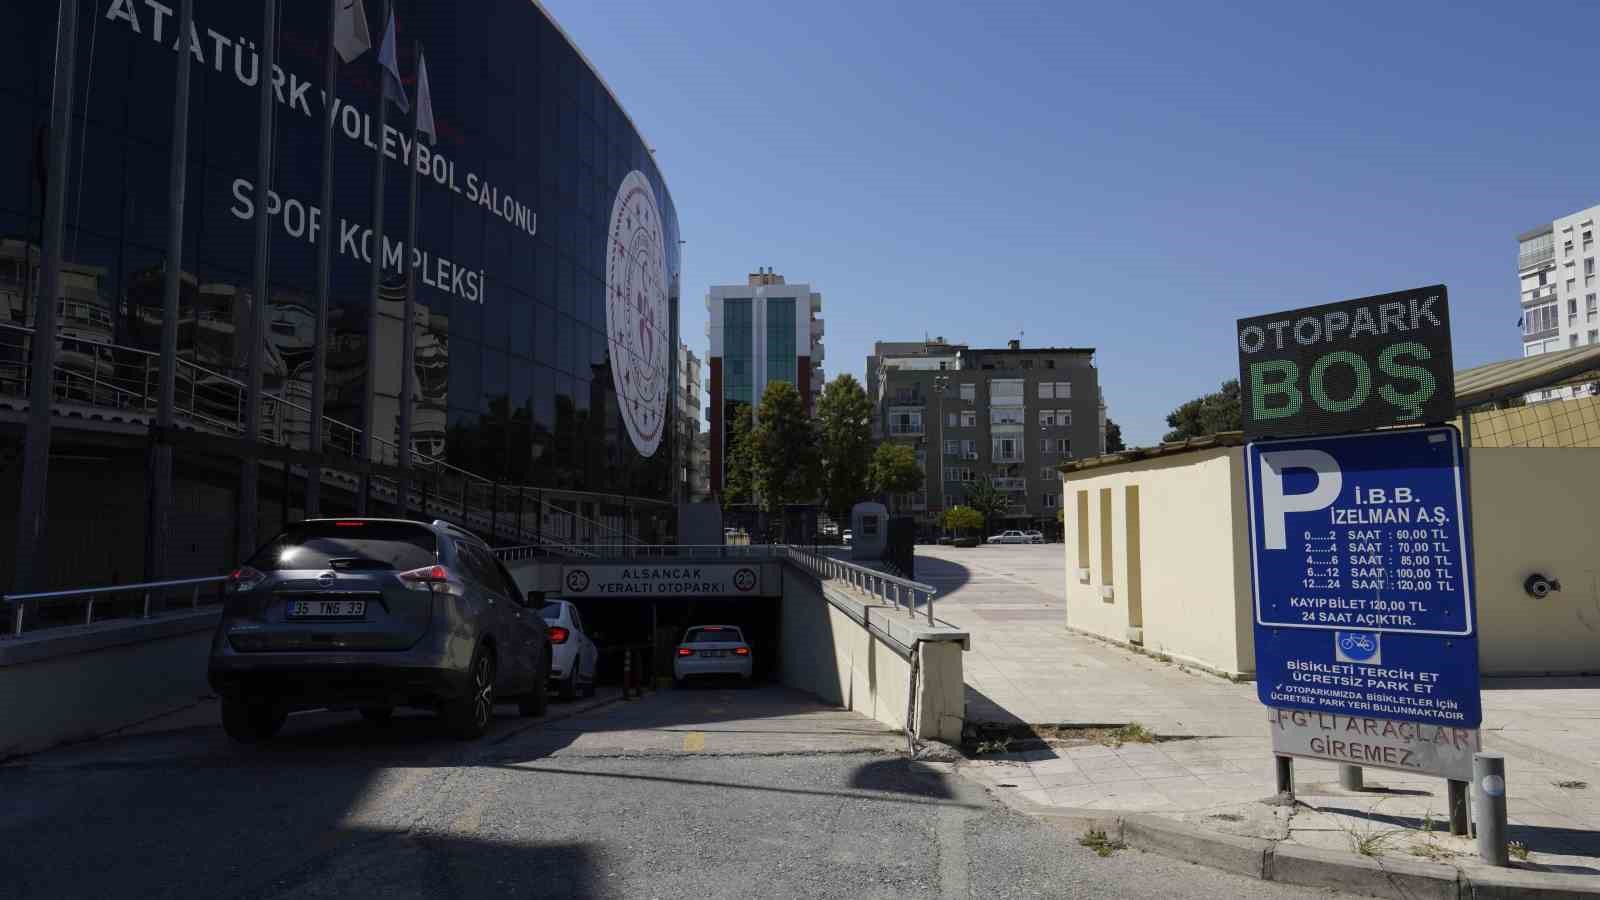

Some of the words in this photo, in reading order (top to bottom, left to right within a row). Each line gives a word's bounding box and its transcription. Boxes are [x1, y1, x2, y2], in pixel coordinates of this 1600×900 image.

[321, 89, 461, 193] VOLEYBOL
[466, 173, 537, 236] SALONU
[1240, 296, 1441, 353] OTOPARK
[1251, 342, 1436, 422] BOŞ
[1260, 449, 1343, 549] P
[1355, 486, 1420, 504] İ.B.B.
[1331, 506, 1410, 524] İZELMAN
[1416, 506, 1450, 526] A.Ş.
[1348, 530, 1381, 539] SAAT
[1431, 529, 1448, 539] TL
[1348, 543, 1382, 552] SAAT
[1432, 543, 1450, 552] TL
[1350, 556, 1383, 565] SAAT
[1434, 556, 1452, 565] TL
[622, 569, 702, 579] ALSANCAK
[1351, 568, 1385, 577] SAAT
[1436, 569, 1453, 578] TL
[598, 583, 653, 593] YERALTI
[658, 583, 725, 593] OTOPARKI
[1352, 580, 1385, 589] SAAT
[1437, 582, 1454, 591] TL
[1369, 600, 1406, 612] 120,00
[1409, 601, 1427, 612] TL
[1302, 612, 1315, 621] 24
[1319, 612, 1353, 622] SAAT
[1356, 613, 1416, 626] AÇIKTIR.
[1287, 660, 1354, 675] BİSİKLETİ
[1358, 667, 1414, 680] TERCİH
[1419, 672, 1440, 682] ET
[1293, 671, 1363, 687] ÜCRETSİZ
[1367, 680, 1408, 692] PARK
[1414, 683, 1434, 694] ET
[1285, 685, 1363, 700] OTOPARKIMIZDA
[1366, 693, 1433, 707] BİSİKLETLER
[1271, 692, 1315, 705] ÜCRETSİZ
[1319, 698, 1345, 708] PARK
[1347, 700, 1371, 710] YERİ
[1373, 703, 1464, 720] BULUNMAKTADIR
[1345, 716, 1469, 750] ARAÇLAR
